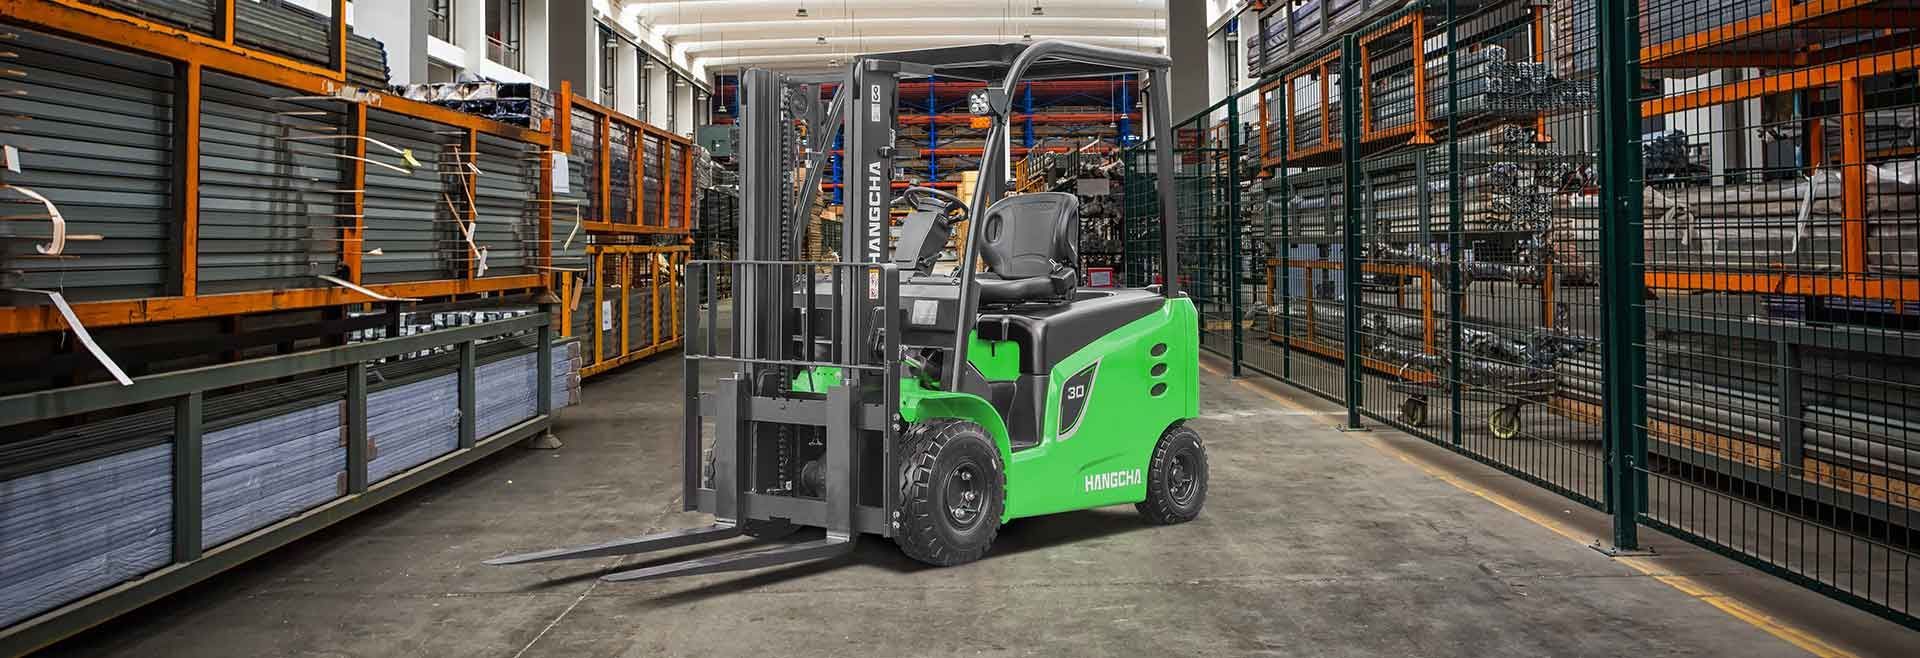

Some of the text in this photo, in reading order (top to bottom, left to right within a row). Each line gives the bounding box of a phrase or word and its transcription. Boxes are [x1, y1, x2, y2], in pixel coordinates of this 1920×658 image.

[868, 161, 881, 264] HANGCHA
[1068, 385, 1085, 400] 30
[1085, 469, 1142, 493] HANGCHA
